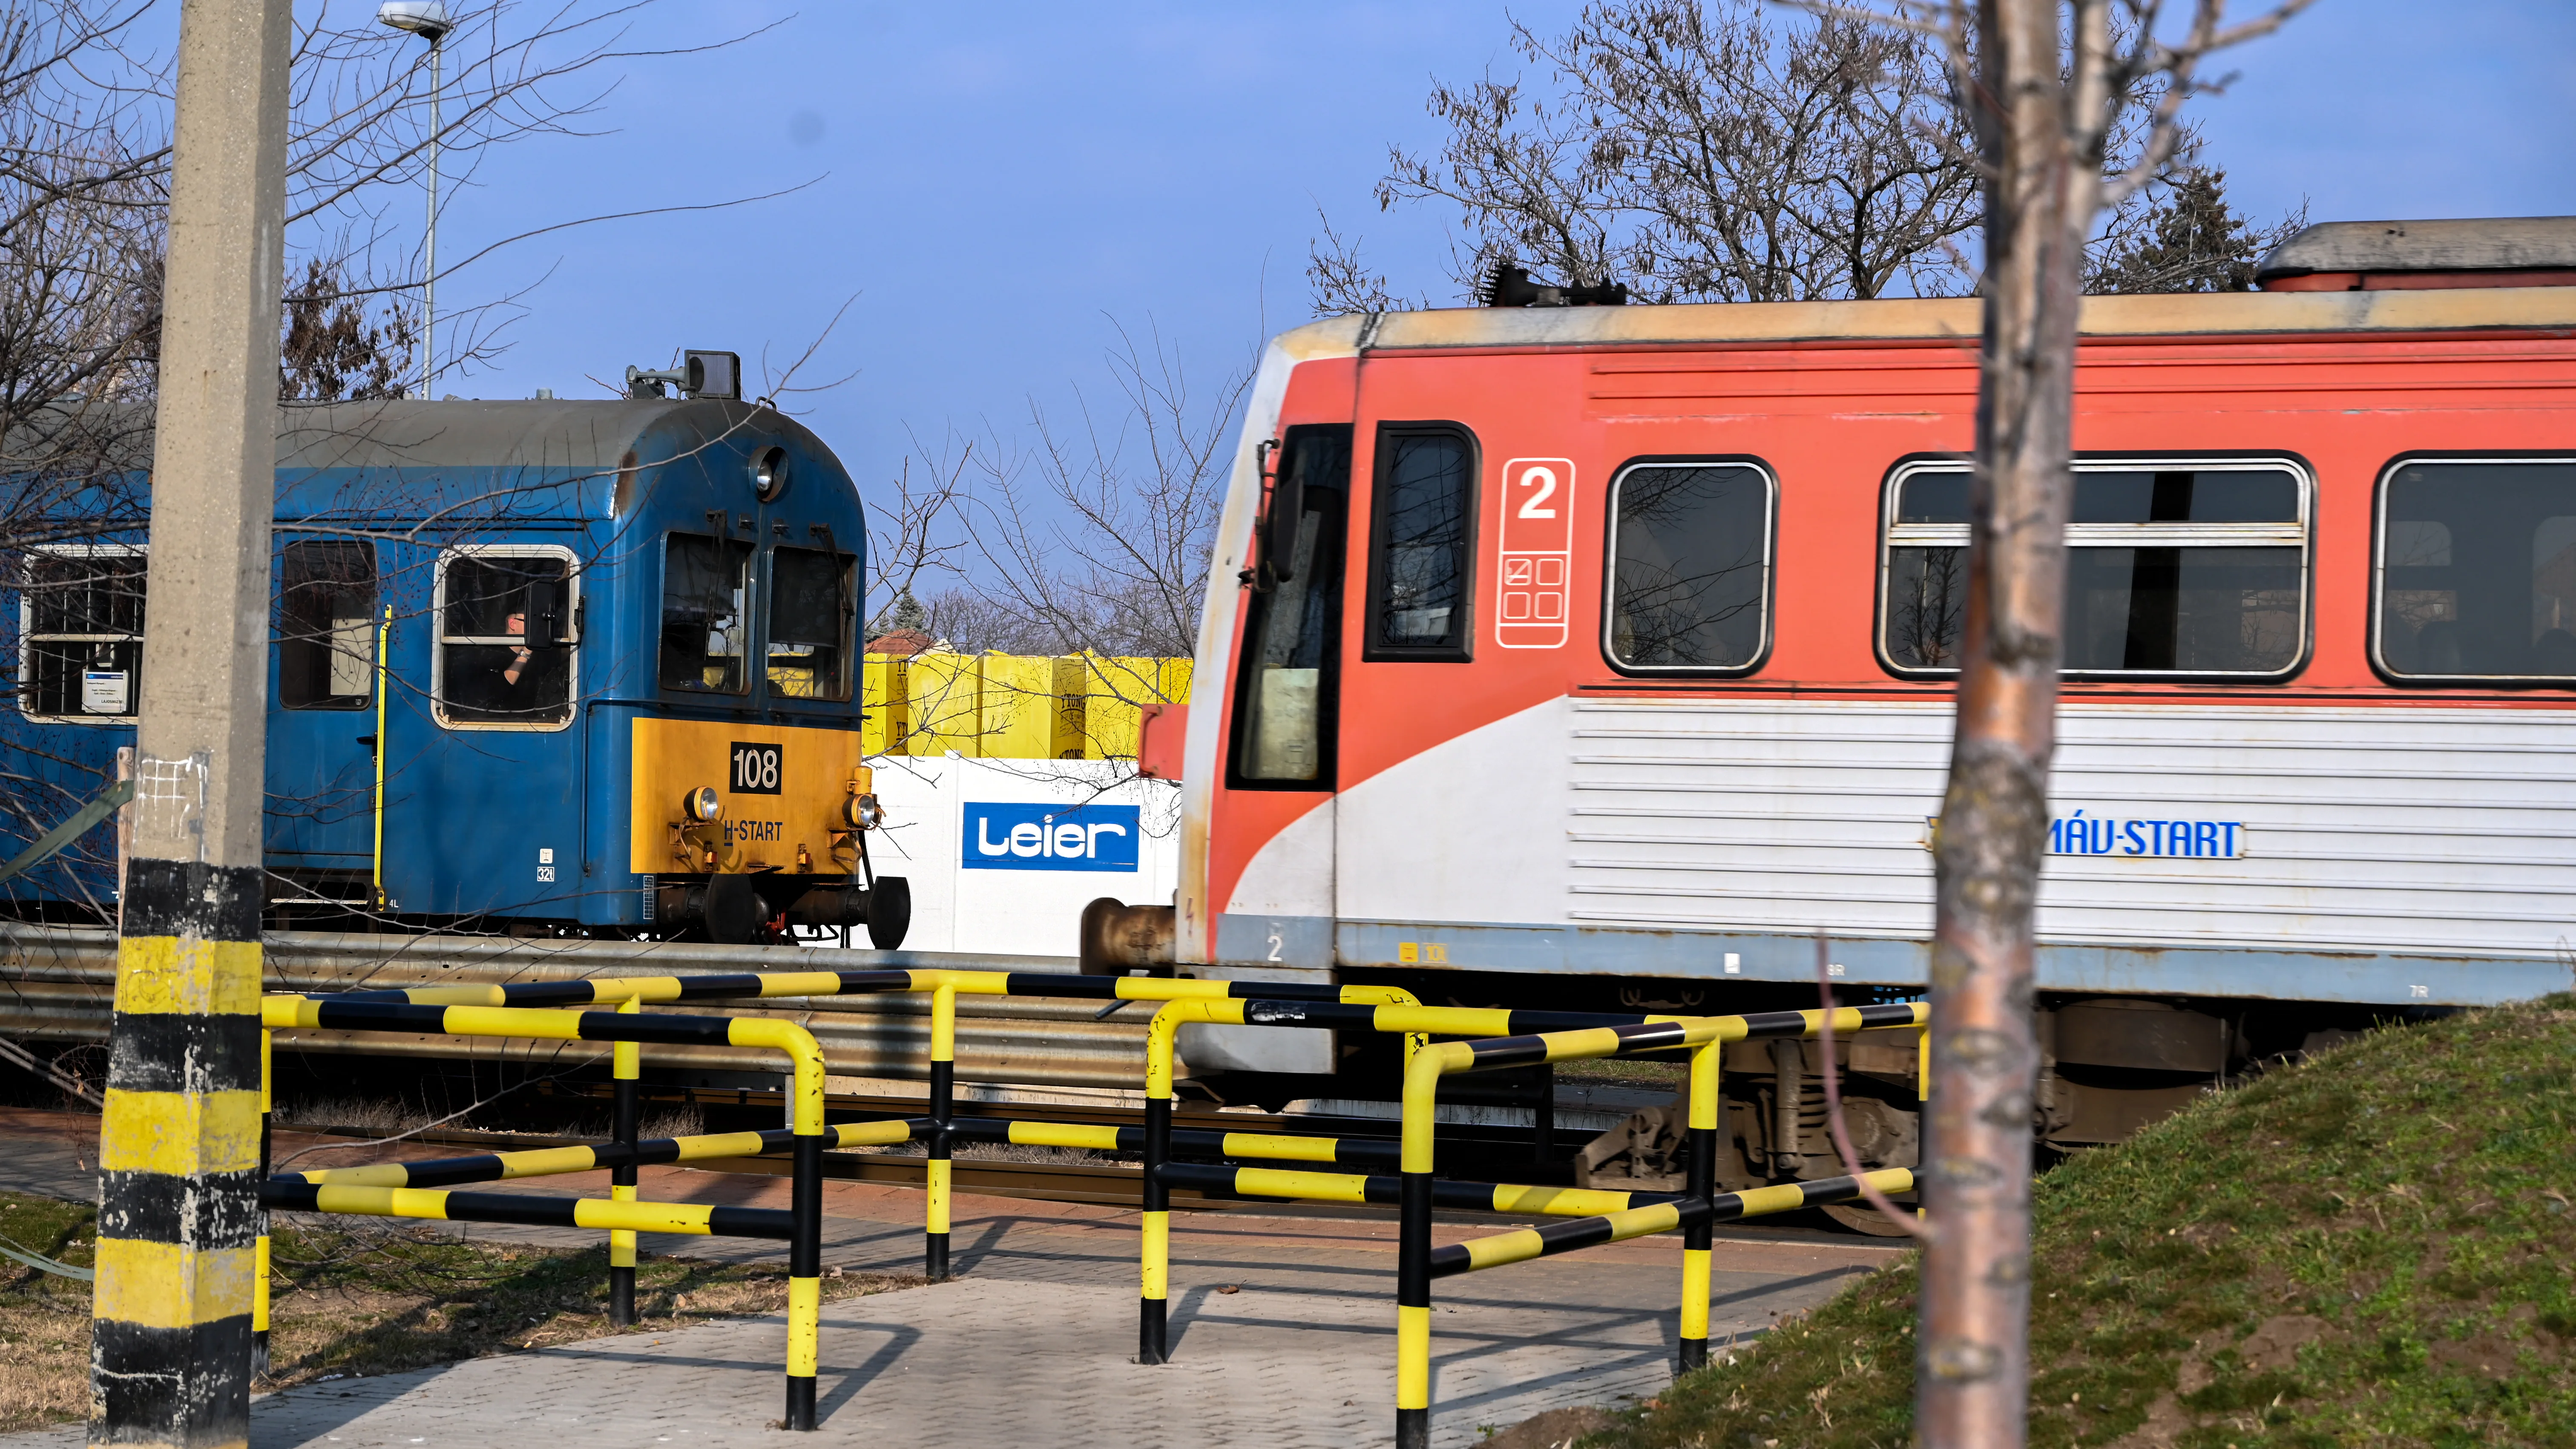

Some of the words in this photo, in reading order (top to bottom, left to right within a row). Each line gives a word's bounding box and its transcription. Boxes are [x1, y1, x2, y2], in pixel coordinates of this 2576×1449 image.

[1518, 466, 1557, 519] 2
[1061, 693, 1086, 710] YTONG
[734, 749, 777, 788] 108
[724, 819, 783, 842] H-START
[978, 814, 1126, 858] Leier
[538, 868, 553, 881] 32t
[389, 899, 399, 908] 4L
[1267, 935, 1282, 961] 2
